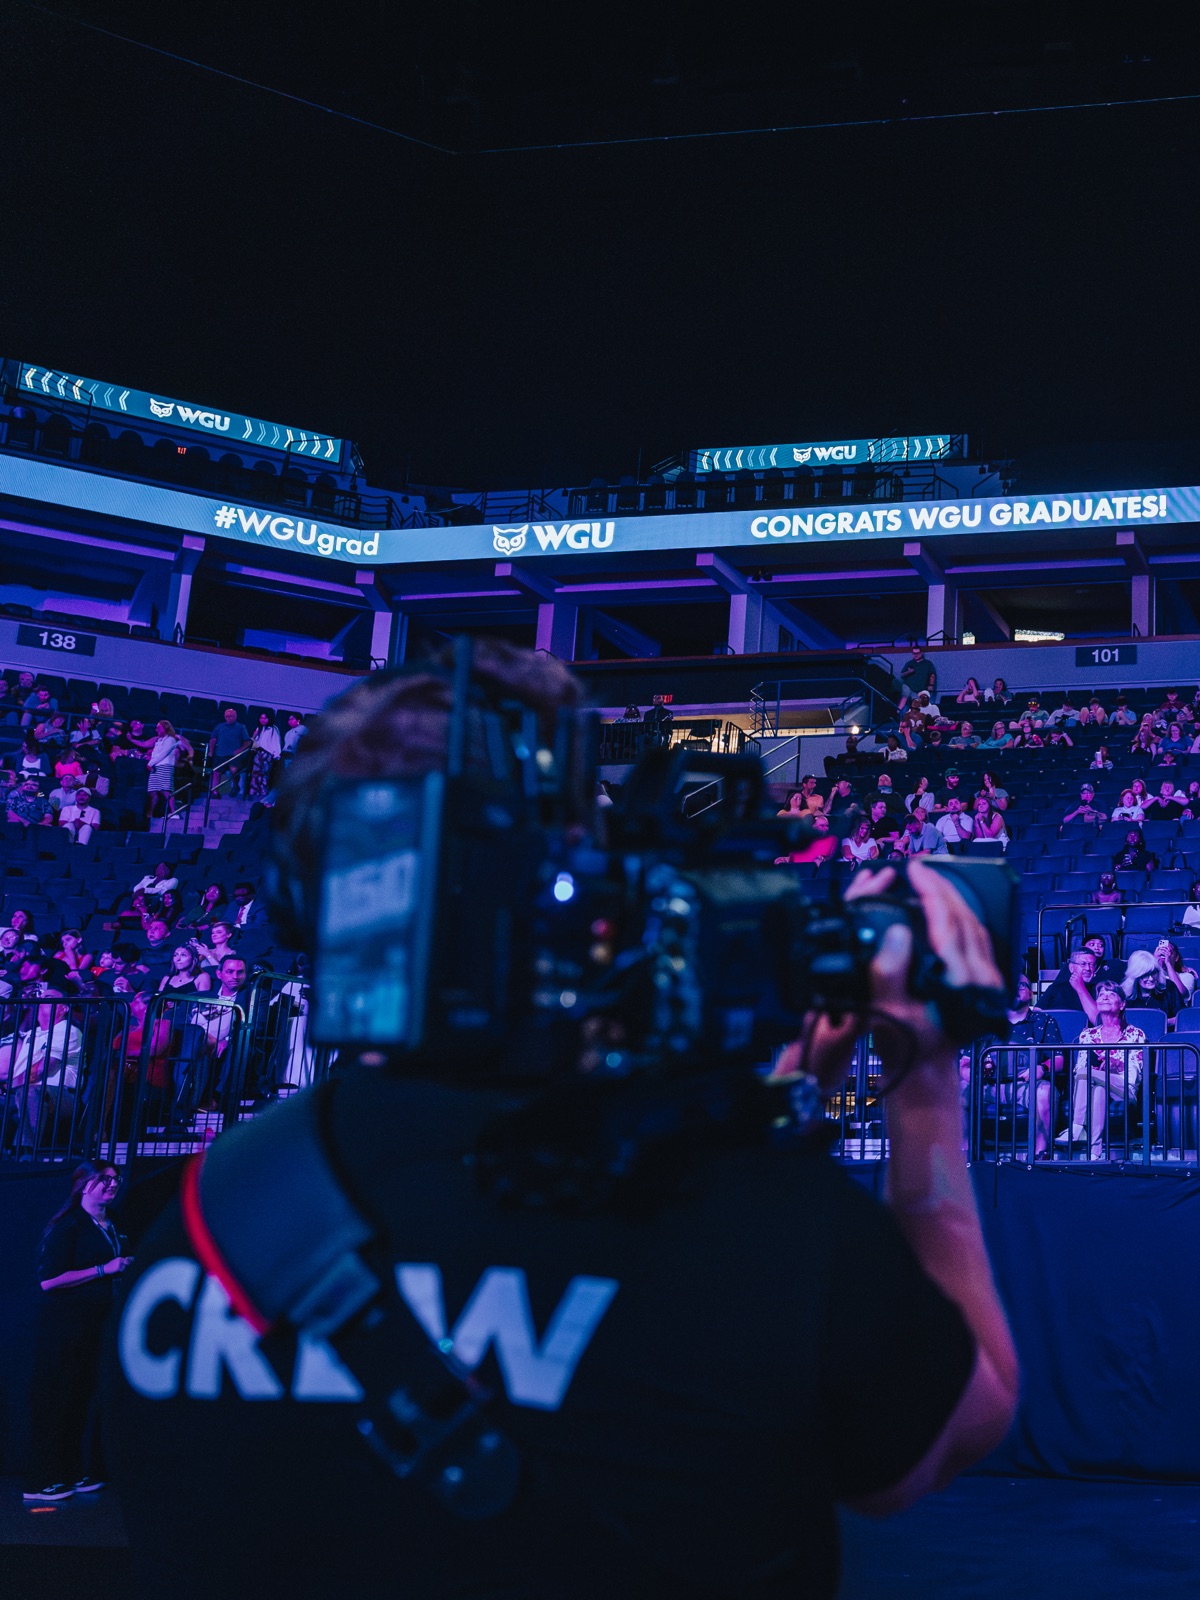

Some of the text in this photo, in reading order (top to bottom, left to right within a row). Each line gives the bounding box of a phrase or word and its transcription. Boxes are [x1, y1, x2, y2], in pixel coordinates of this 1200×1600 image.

[176, 404, 231, 432] WGU
[812, 444, 857, 462] WGU
[750, 494, 1167, 539] CONGRATS WGU GRADUATES!
[214, 505, 380, 557] #WGUgrad
[532, 521, 615, 551] WGU
[39, 631, 76, 651] 138
[1091, 648, 1120, 663] 101
